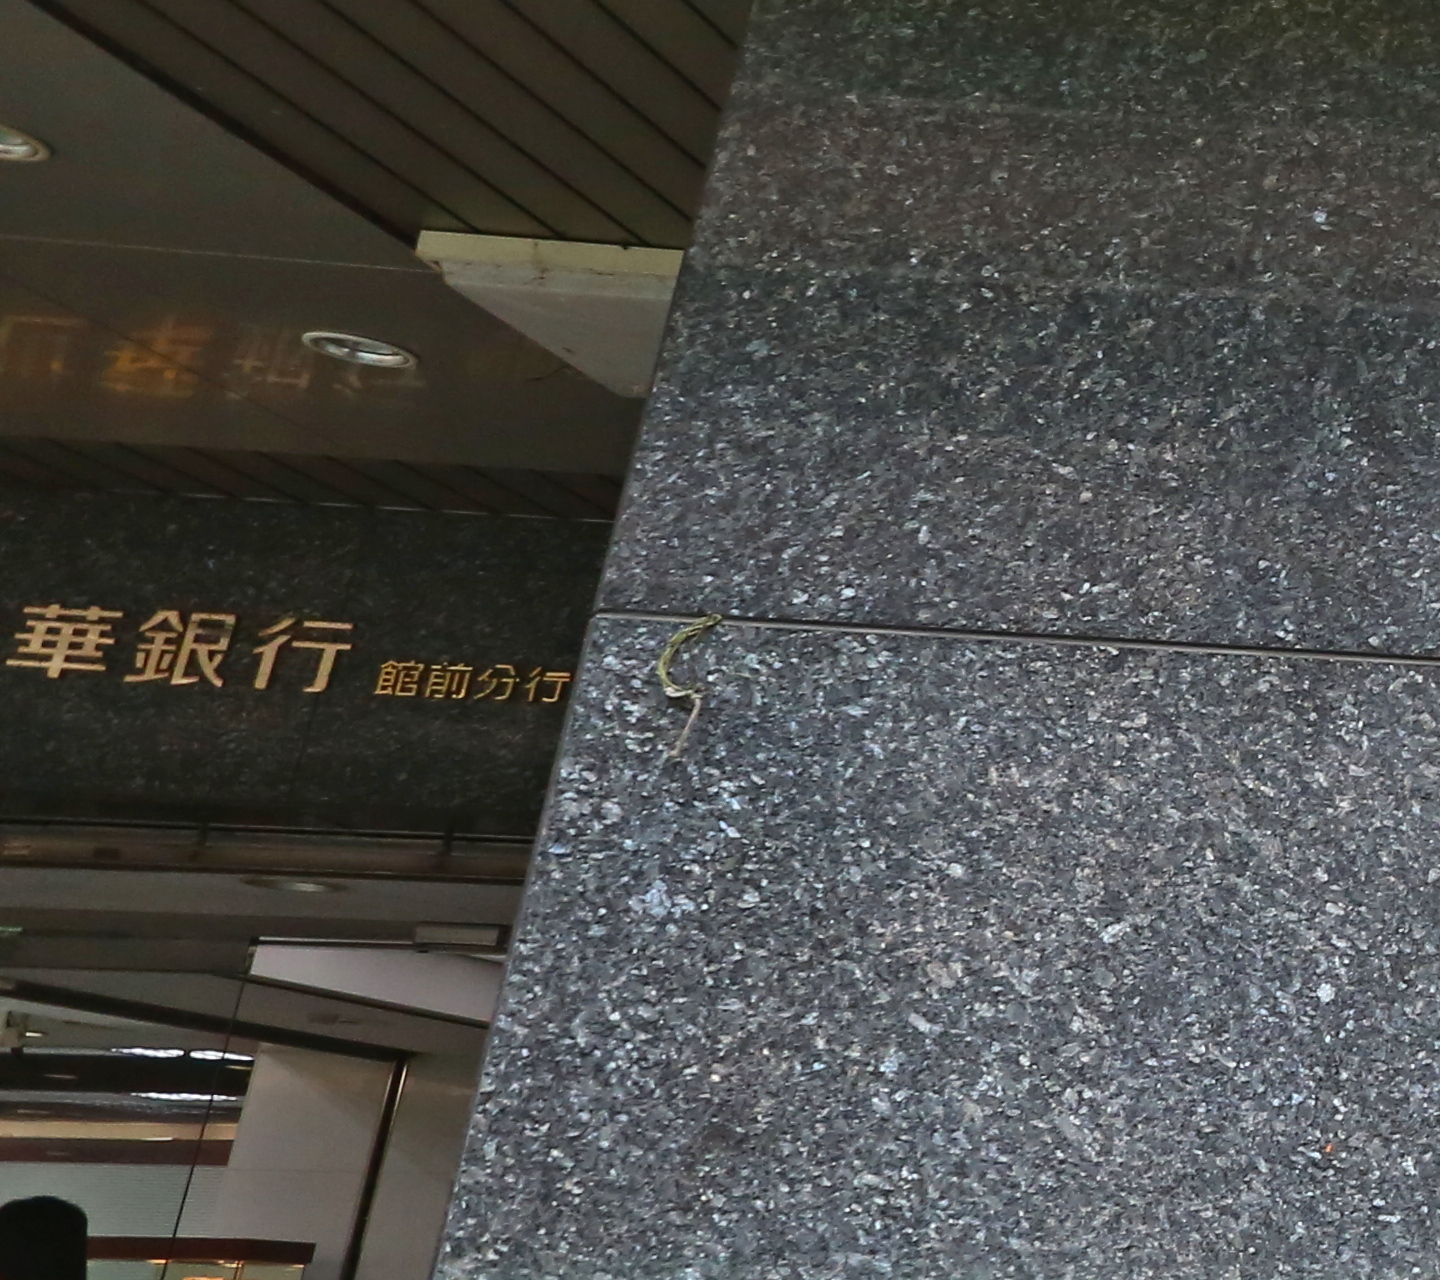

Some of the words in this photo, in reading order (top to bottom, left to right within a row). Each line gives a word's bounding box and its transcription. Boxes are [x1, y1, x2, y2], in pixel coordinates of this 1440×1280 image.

[5, 604, 355, 694] 華銀行
[373, 659, 572, 703] 館前分行
